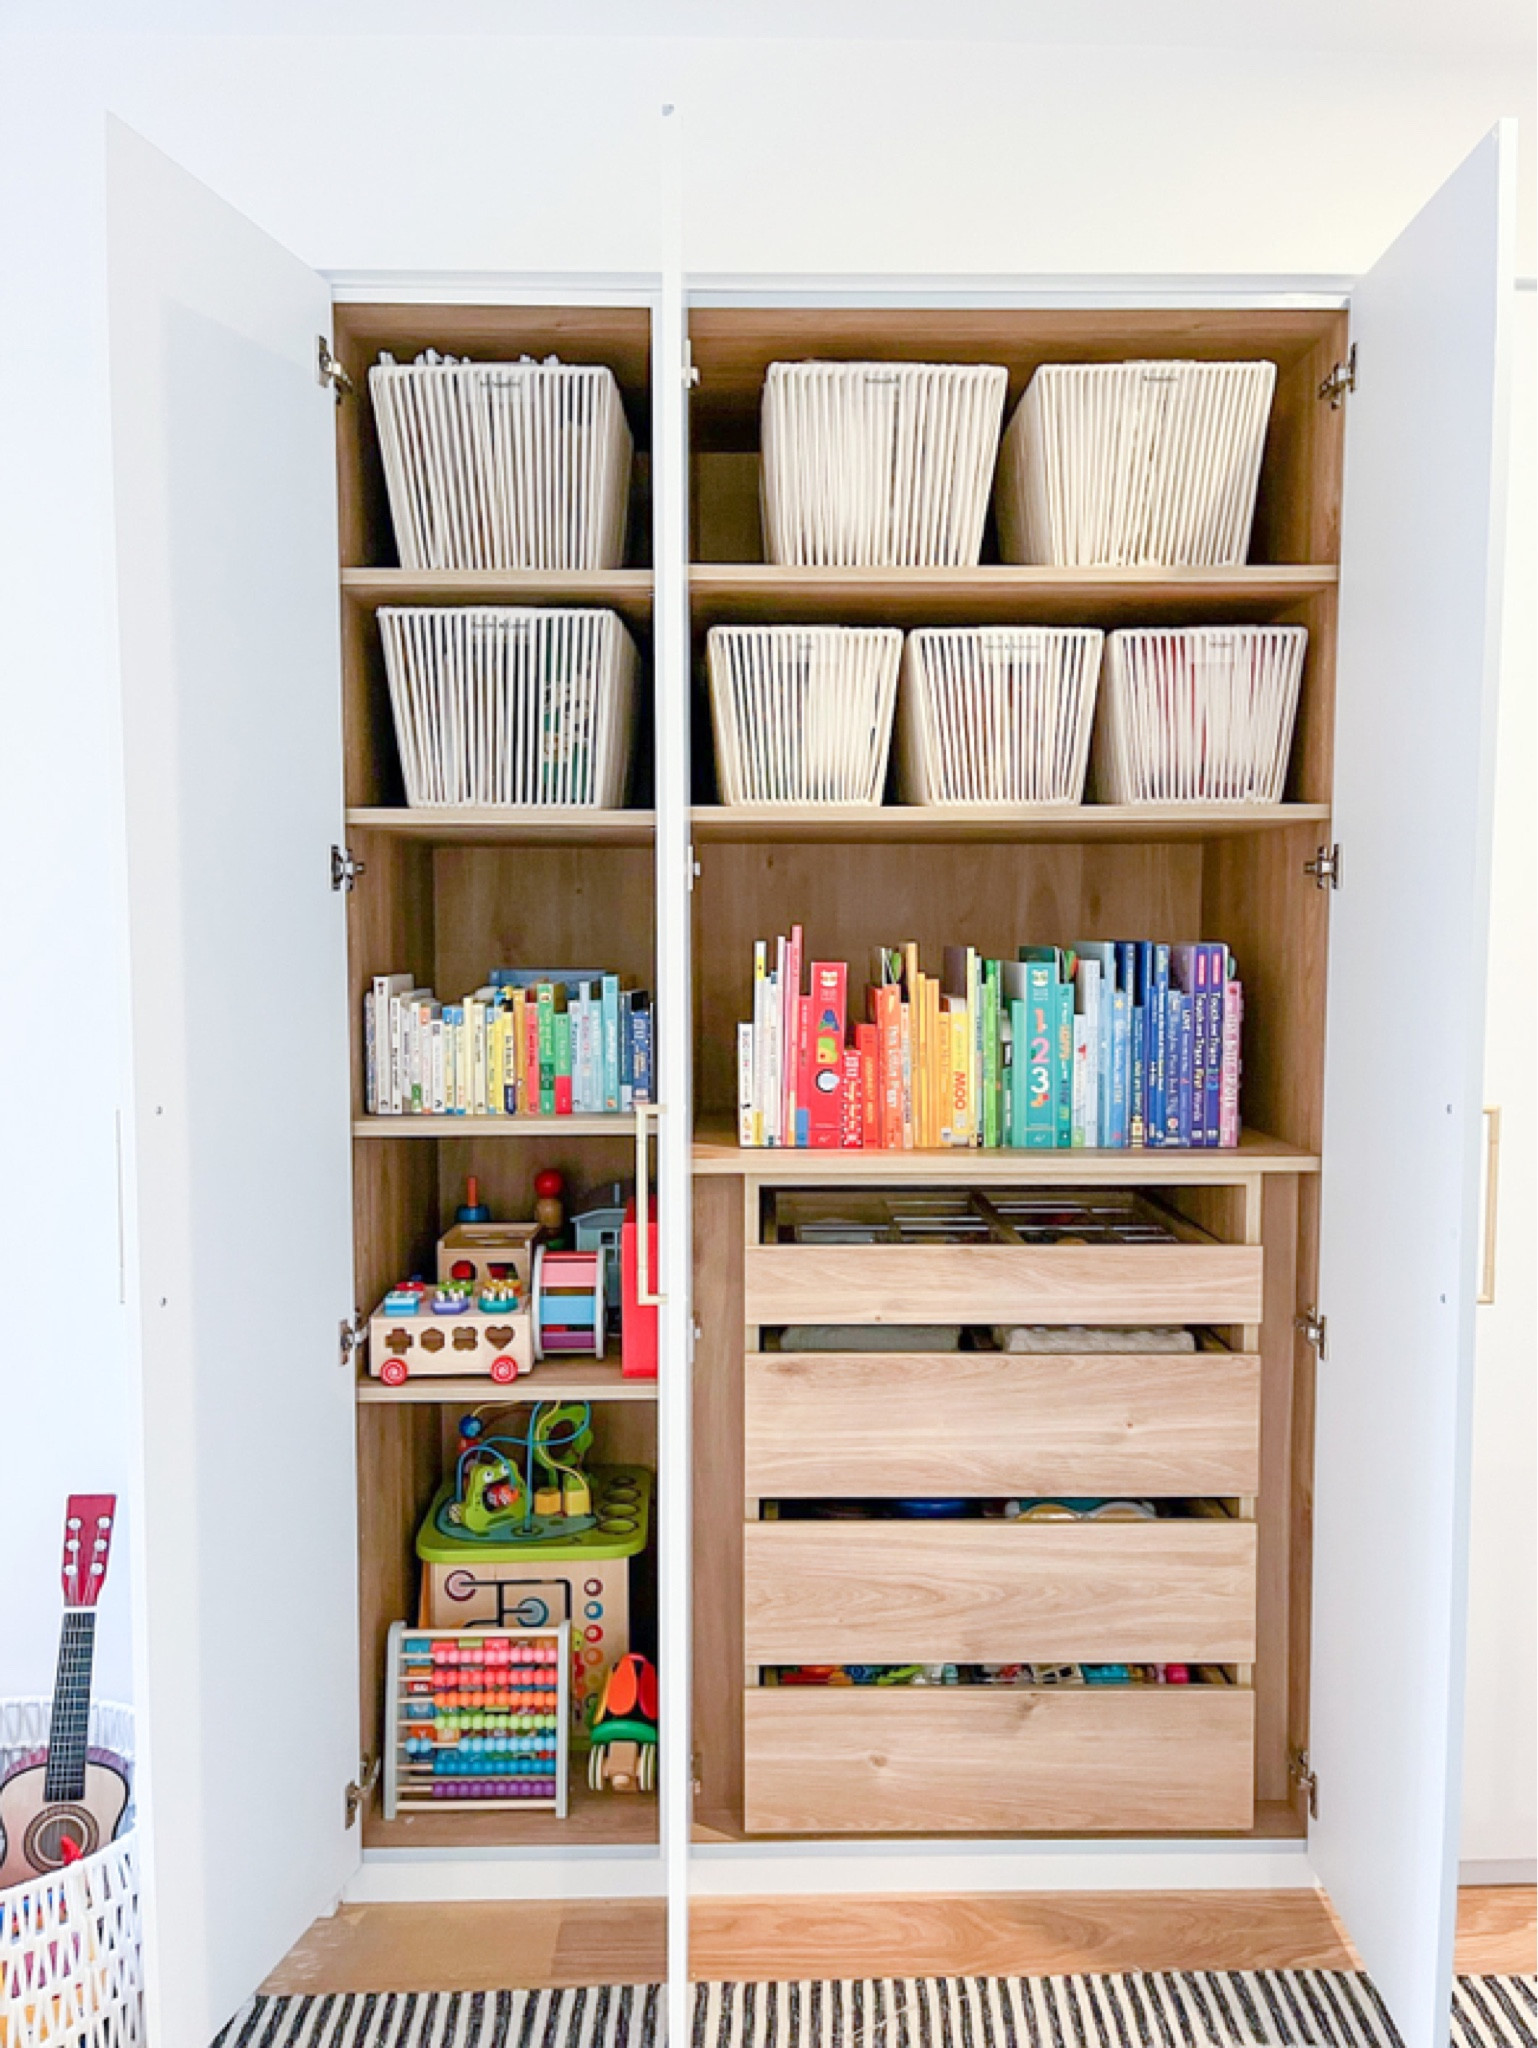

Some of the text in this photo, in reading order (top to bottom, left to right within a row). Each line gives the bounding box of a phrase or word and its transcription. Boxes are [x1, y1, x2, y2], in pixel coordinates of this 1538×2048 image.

[817, 1009, 840, 1032] A
[1034, 1008, 1046, 1034] 1
[816, 1036, 837, 1065] B
[1031, 1037, 1050, 1064] 2
[955, 1071, 966, 1110] MOO
[1031, 1066, 1049, 1094] 3
